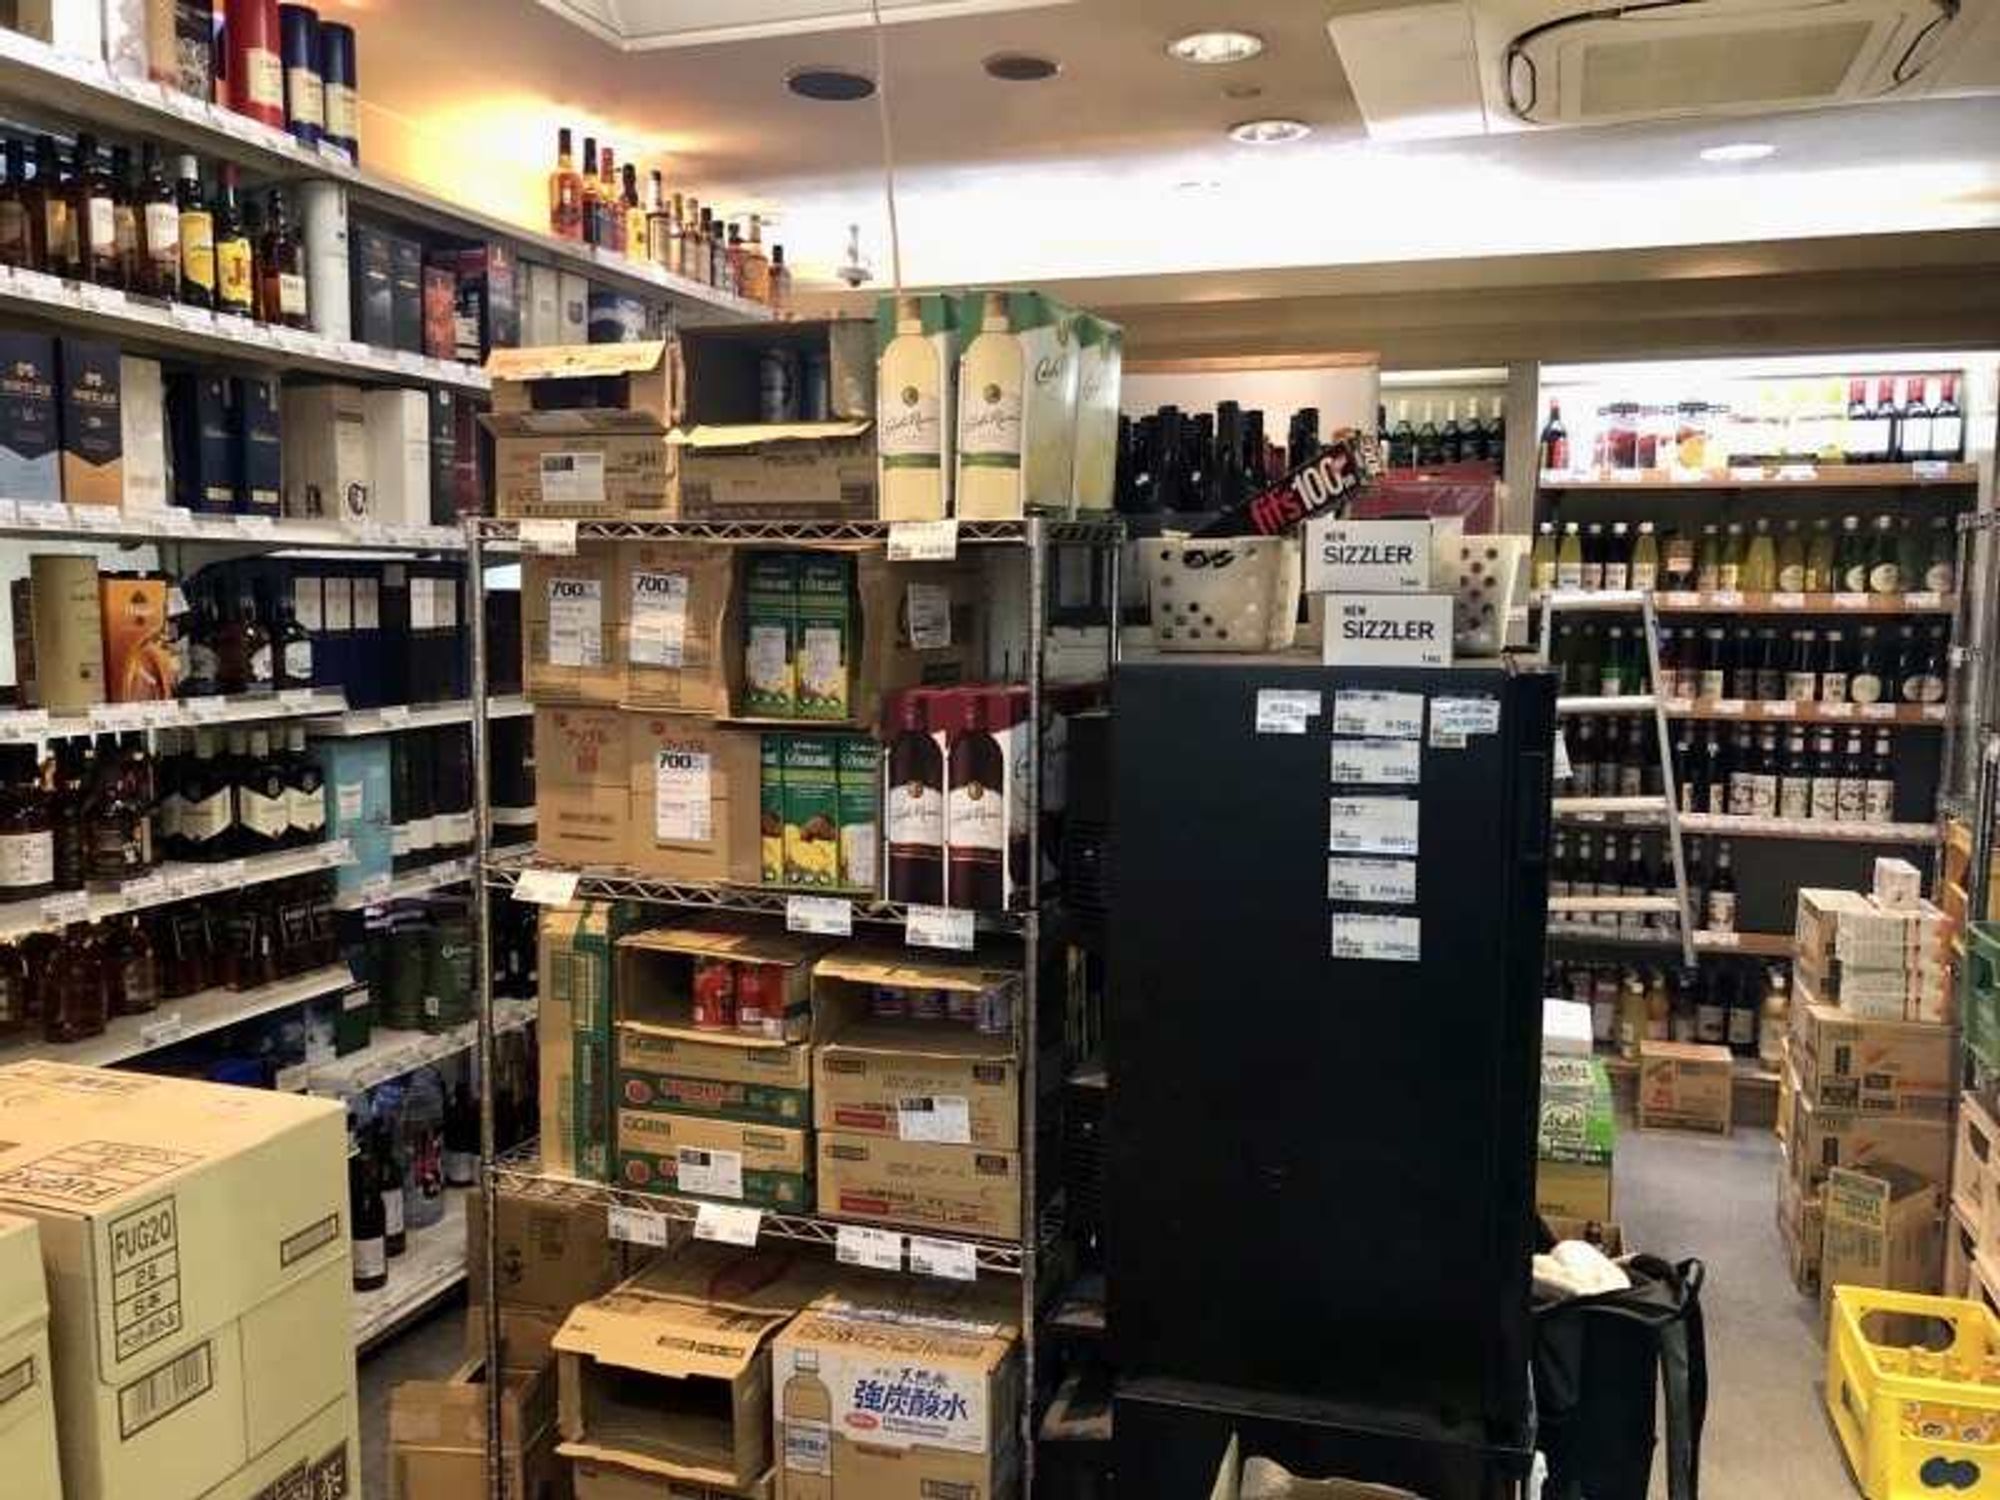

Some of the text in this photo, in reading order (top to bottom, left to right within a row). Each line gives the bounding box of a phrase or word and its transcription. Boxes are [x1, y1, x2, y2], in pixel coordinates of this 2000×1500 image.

[1323, 545, 1413, 565] SIZZLER
[1343, 620, 1434, 640] SIZZLER
[659, 752, 692, 769] 700
[114, 1210, 172, 1261] FUG20
[853, 1379, 969, 1421] 強炭酸水
